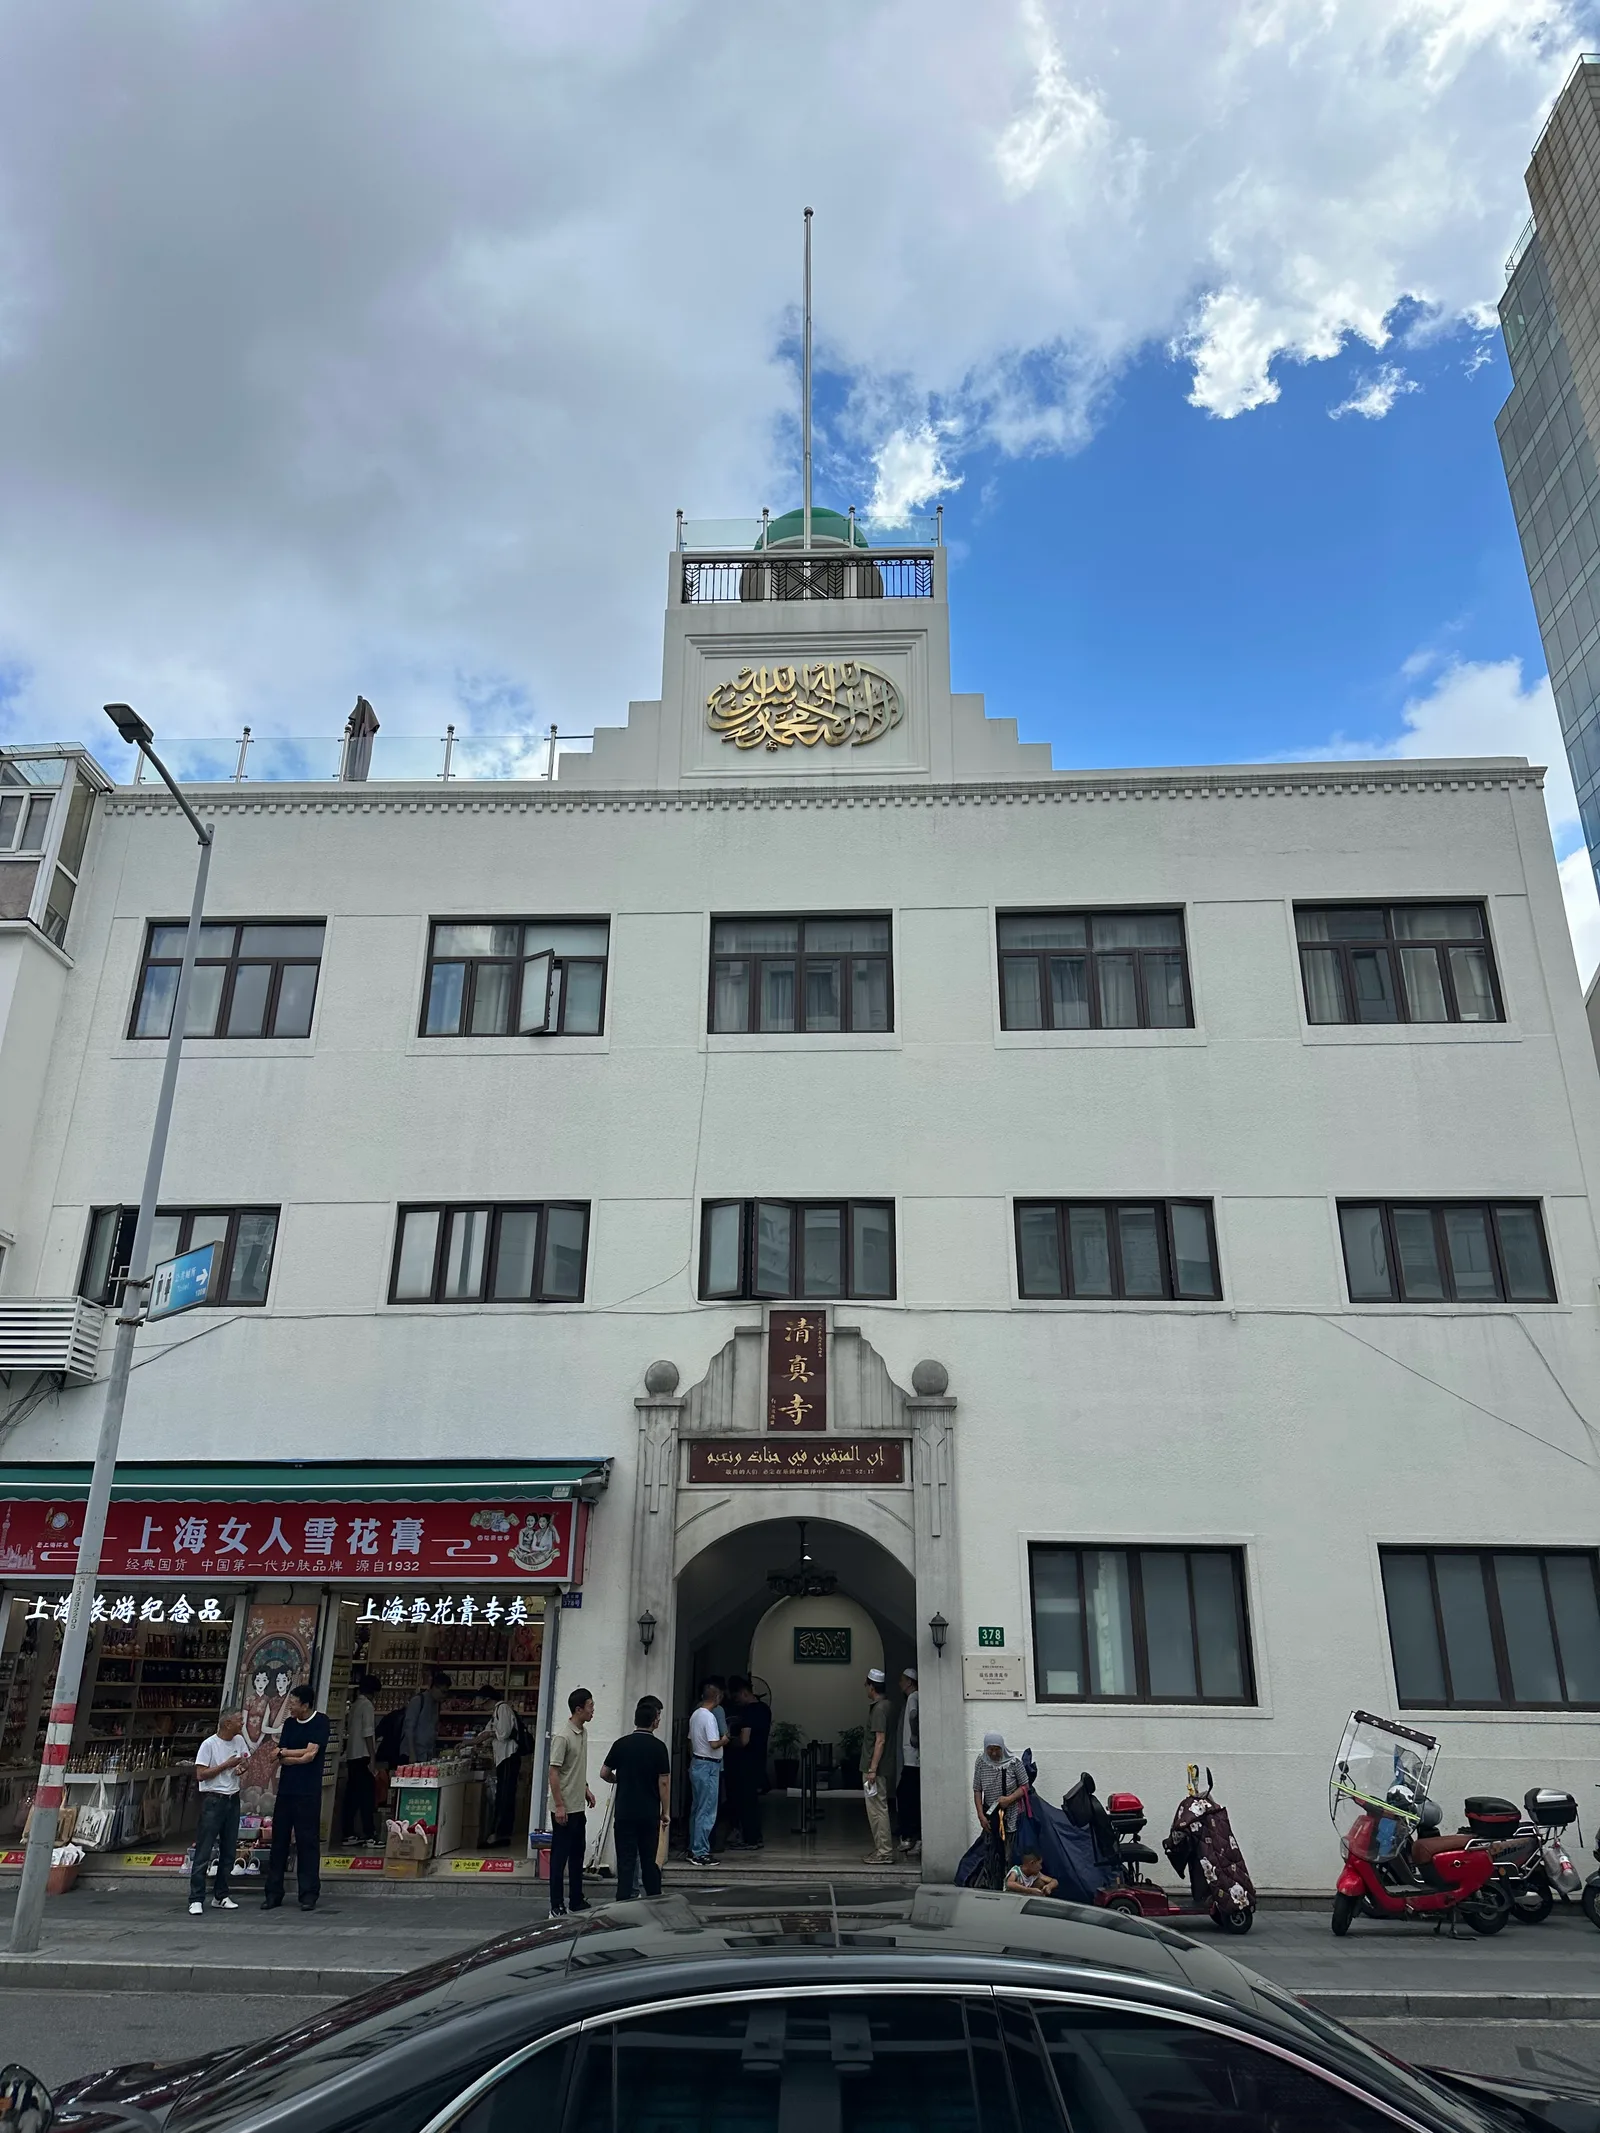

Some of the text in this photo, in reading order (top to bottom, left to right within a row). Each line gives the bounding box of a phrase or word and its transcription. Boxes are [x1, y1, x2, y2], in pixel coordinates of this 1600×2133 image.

[778, 1317, 815, 1425] 清真寺
[128, 1516, 425, 1555] 上海女人雪花膏
[125, 1558, 420, 1573] 经典国货 中国第一代护肤品牌 源自1932
[357, 1595, 528, 1626] 上海雪花膏专卖
[982, 1629, 1001, 1640] 378
